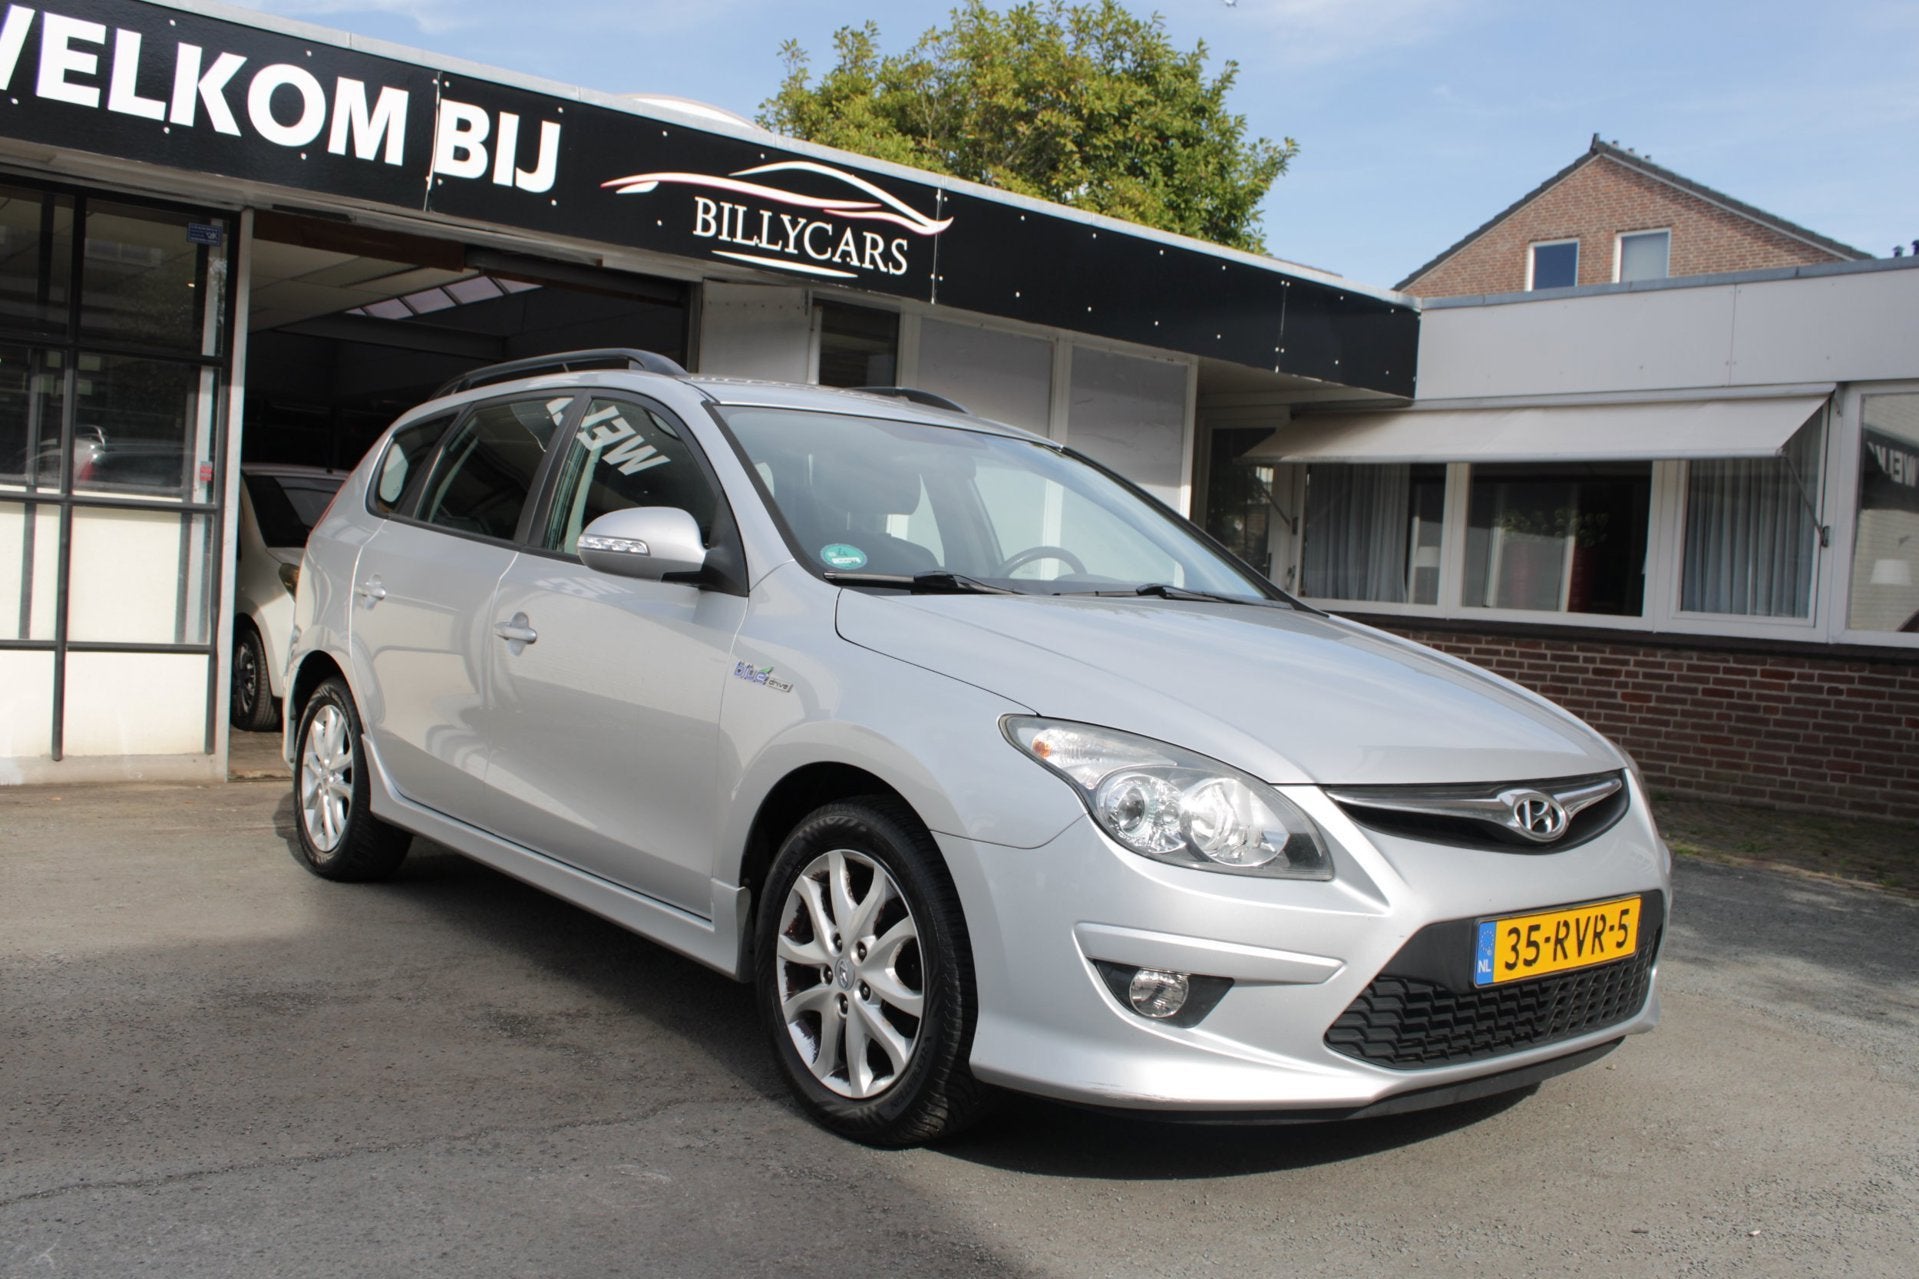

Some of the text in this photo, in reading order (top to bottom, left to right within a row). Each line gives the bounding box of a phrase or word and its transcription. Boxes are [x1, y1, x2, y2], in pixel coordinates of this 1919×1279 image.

[431, 98, 561, 193] BIJ
[692, 196, 909, 276] BILLYCARS
[1478, 908, 1631, 973] NL 35-RVR-5
